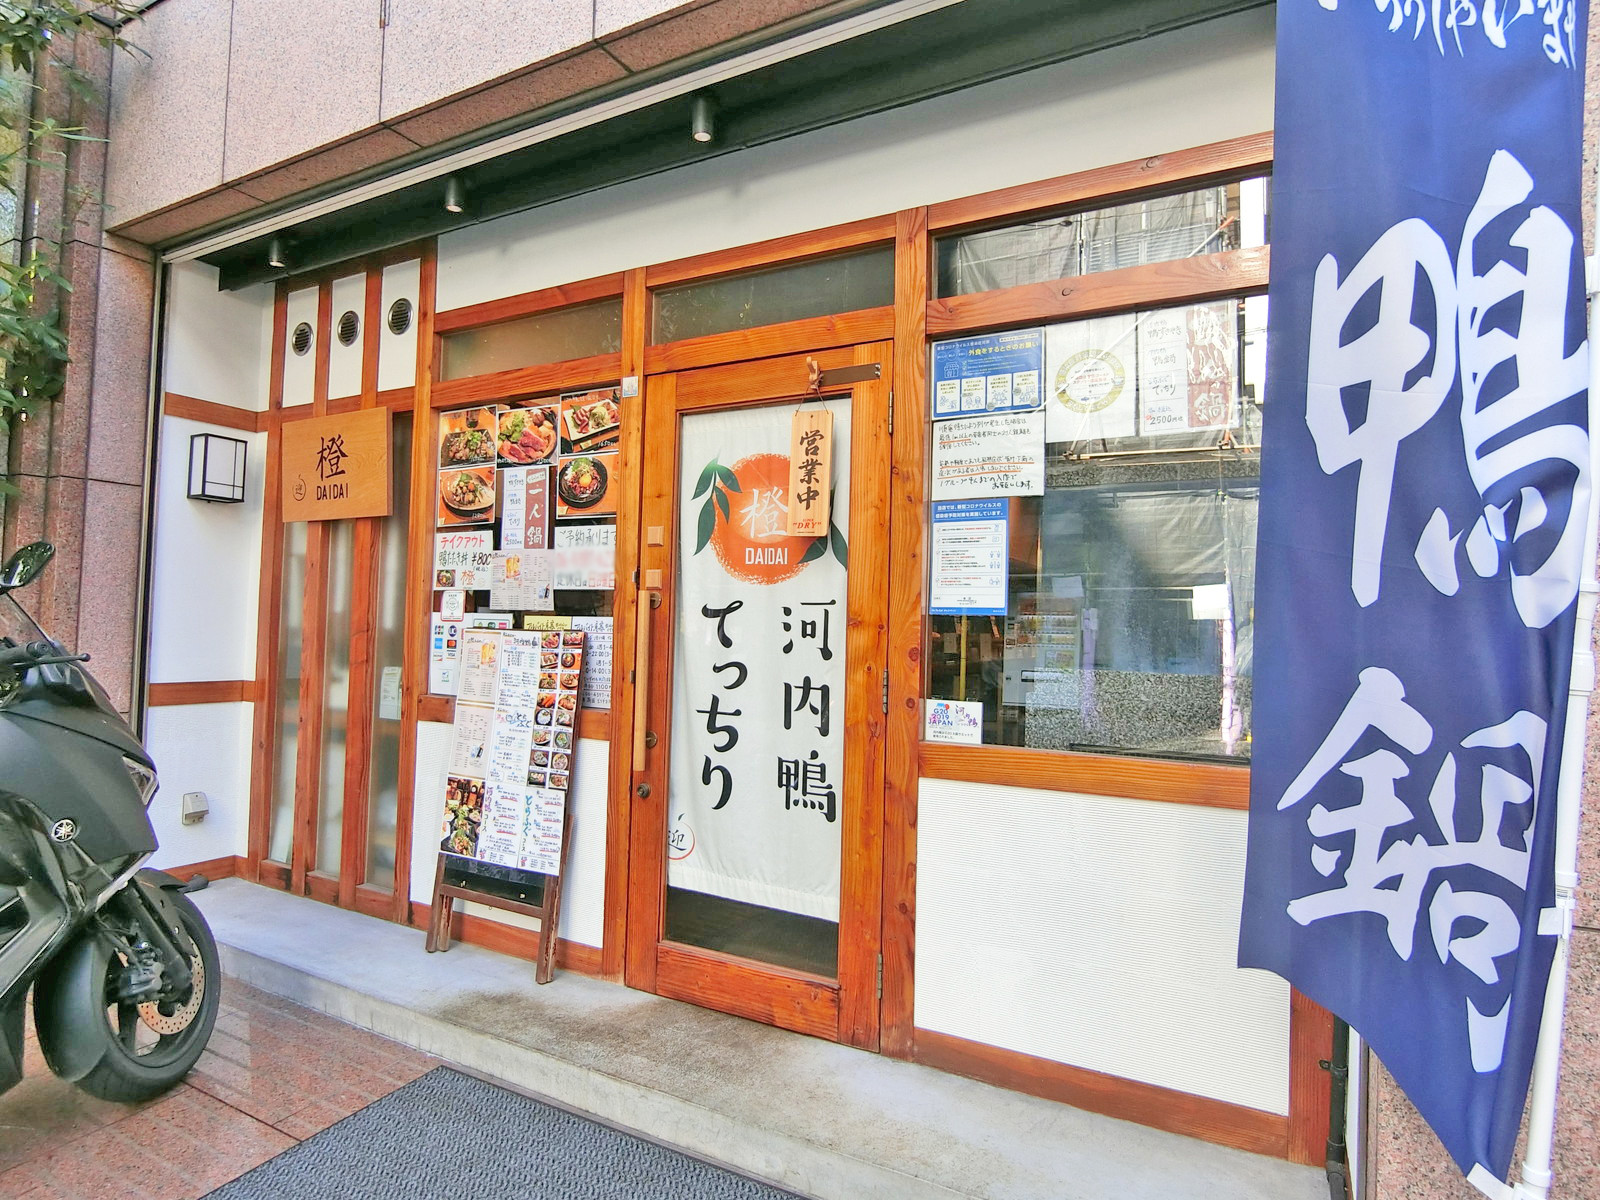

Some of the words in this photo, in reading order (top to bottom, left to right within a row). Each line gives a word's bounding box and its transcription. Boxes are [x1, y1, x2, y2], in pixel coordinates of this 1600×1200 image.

[968, 341, 1039, 356] 外食をするときのお願い
[316, 433, 349, 482] 橙
[796, 429, 825, 511] 営業中
[316, 483, 349, 501] DAIDAI
[739, 486, 788, 538] 橙
[528, 488, 543, 546] 一人鍋
[440, 535, 485, 549] テイクアウト
[745, 547, 788, 565] DAIDAI
[696, 600, 748, 811] てっちり
[777, 599, 837, 823] 河内鴨
[928, 718, 953, 727] JAPAN
[931, 713, 950, 721] 2019
[522, 795, 533, 837] とらふぐ
